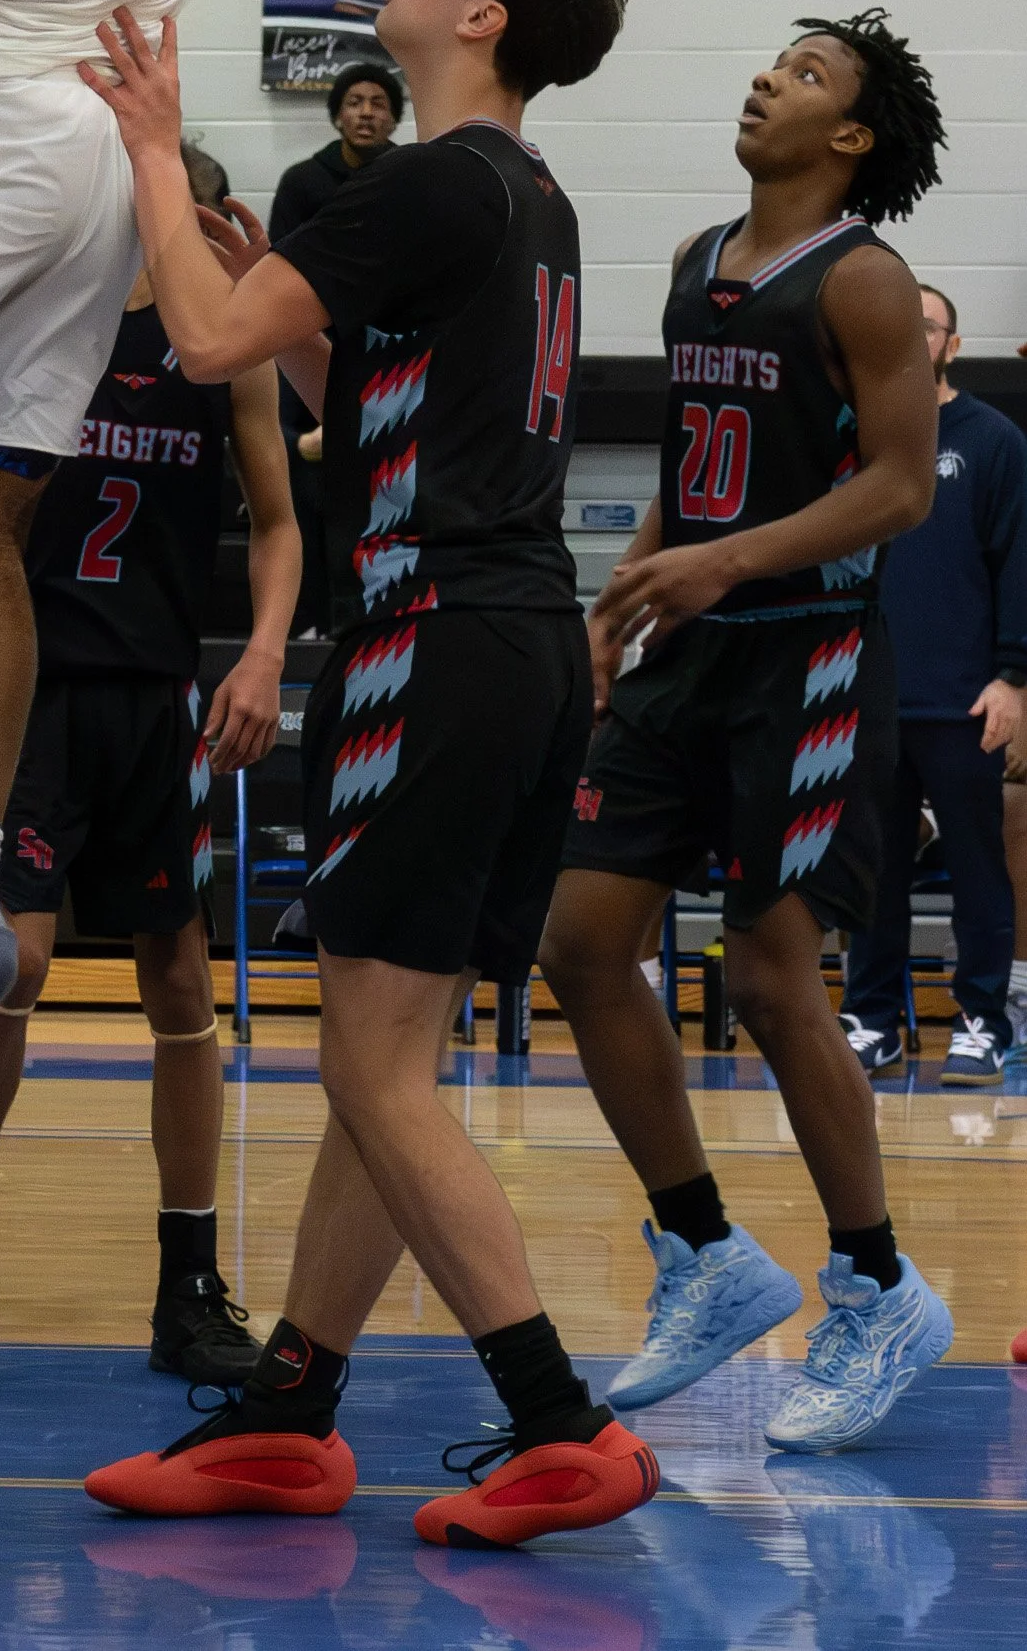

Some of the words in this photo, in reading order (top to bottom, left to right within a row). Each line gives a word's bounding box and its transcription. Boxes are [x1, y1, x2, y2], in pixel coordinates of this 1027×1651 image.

[525, 262, 575, 443] 14
[77, 419, 202, 466] EIGHTS
[679, 401, 751, 523] 20
[76, 476, 141, 583] 2
